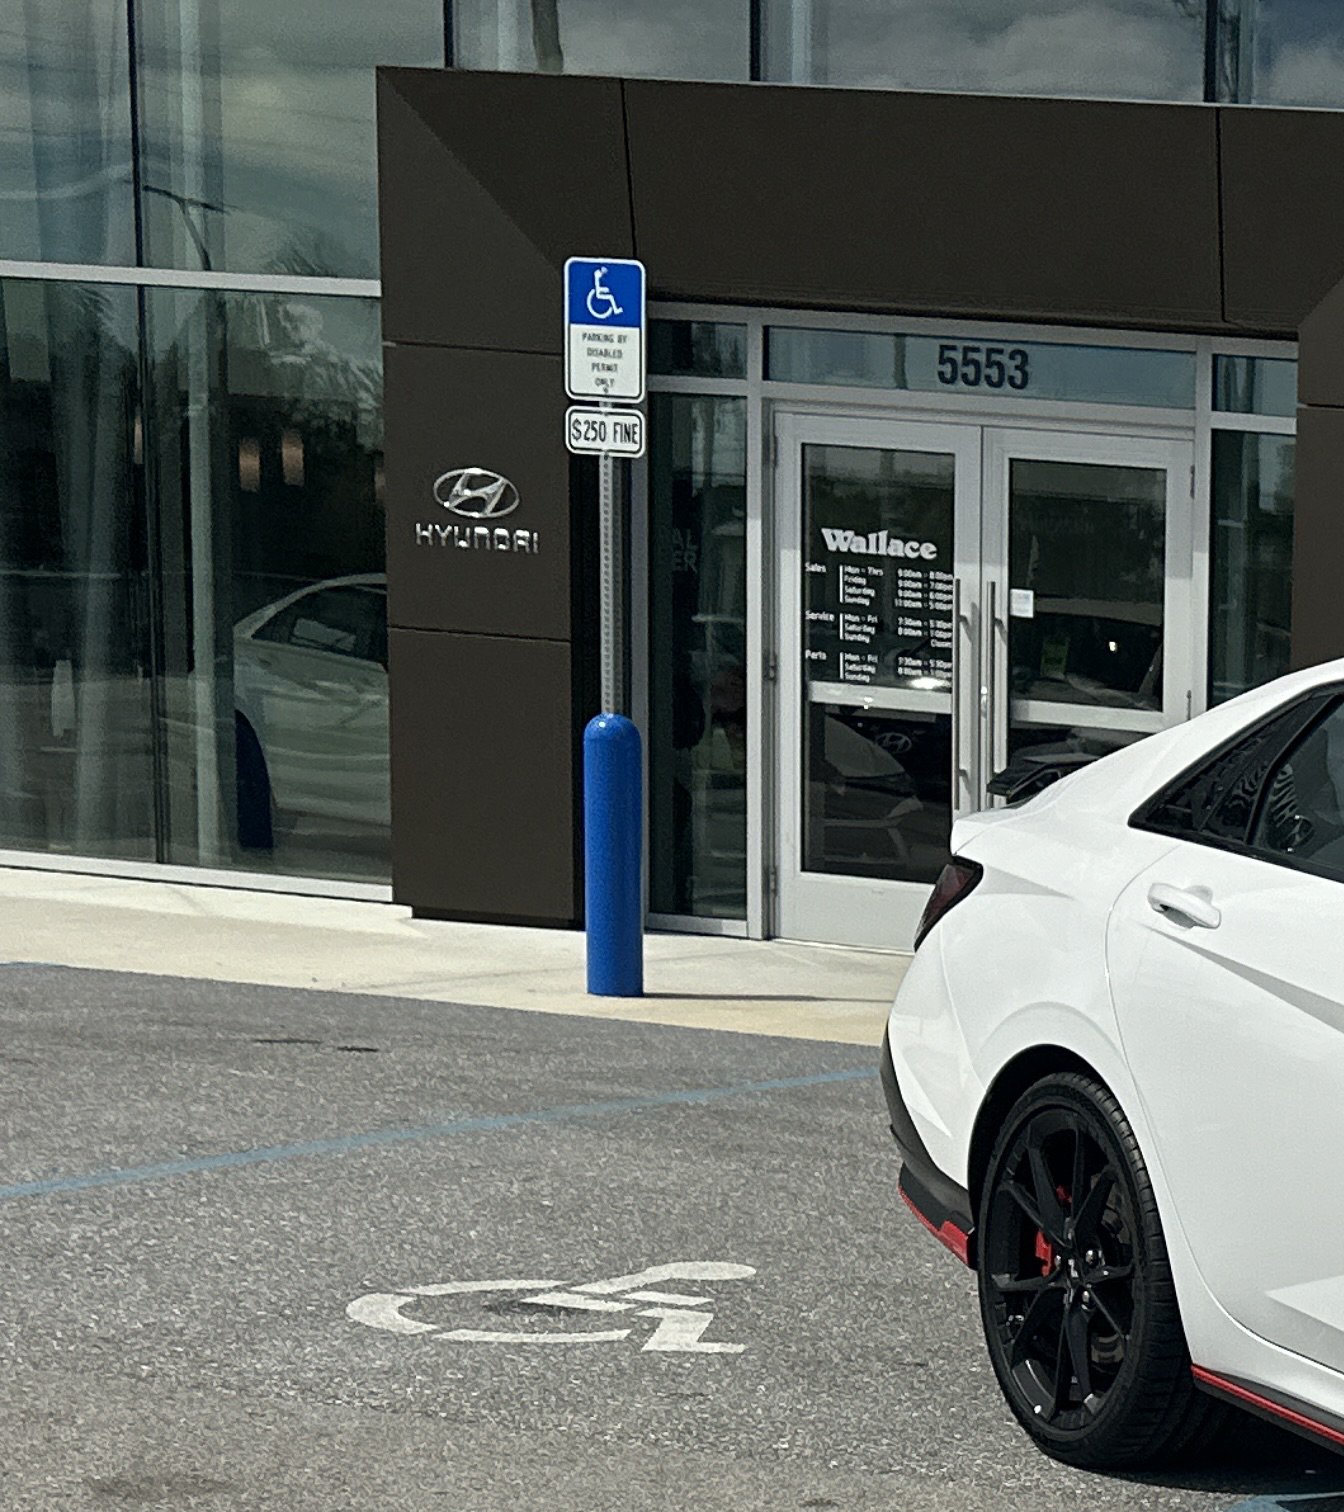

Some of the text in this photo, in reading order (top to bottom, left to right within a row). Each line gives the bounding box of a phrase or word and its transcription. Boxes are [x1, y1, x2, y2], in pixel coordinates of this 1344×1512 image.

[582, 333, 627, 344] PARKING BY
[587, 347, 622, 359] DISABLED
[591, 362, 618, 373] PERMIT
[937, 343, 1029, 390] 5553
[572, 418, 638, 444] $250 FINE
[415, 523, 539, 554] HYUNDAI
[821, 527, 938, 560] Wallace
